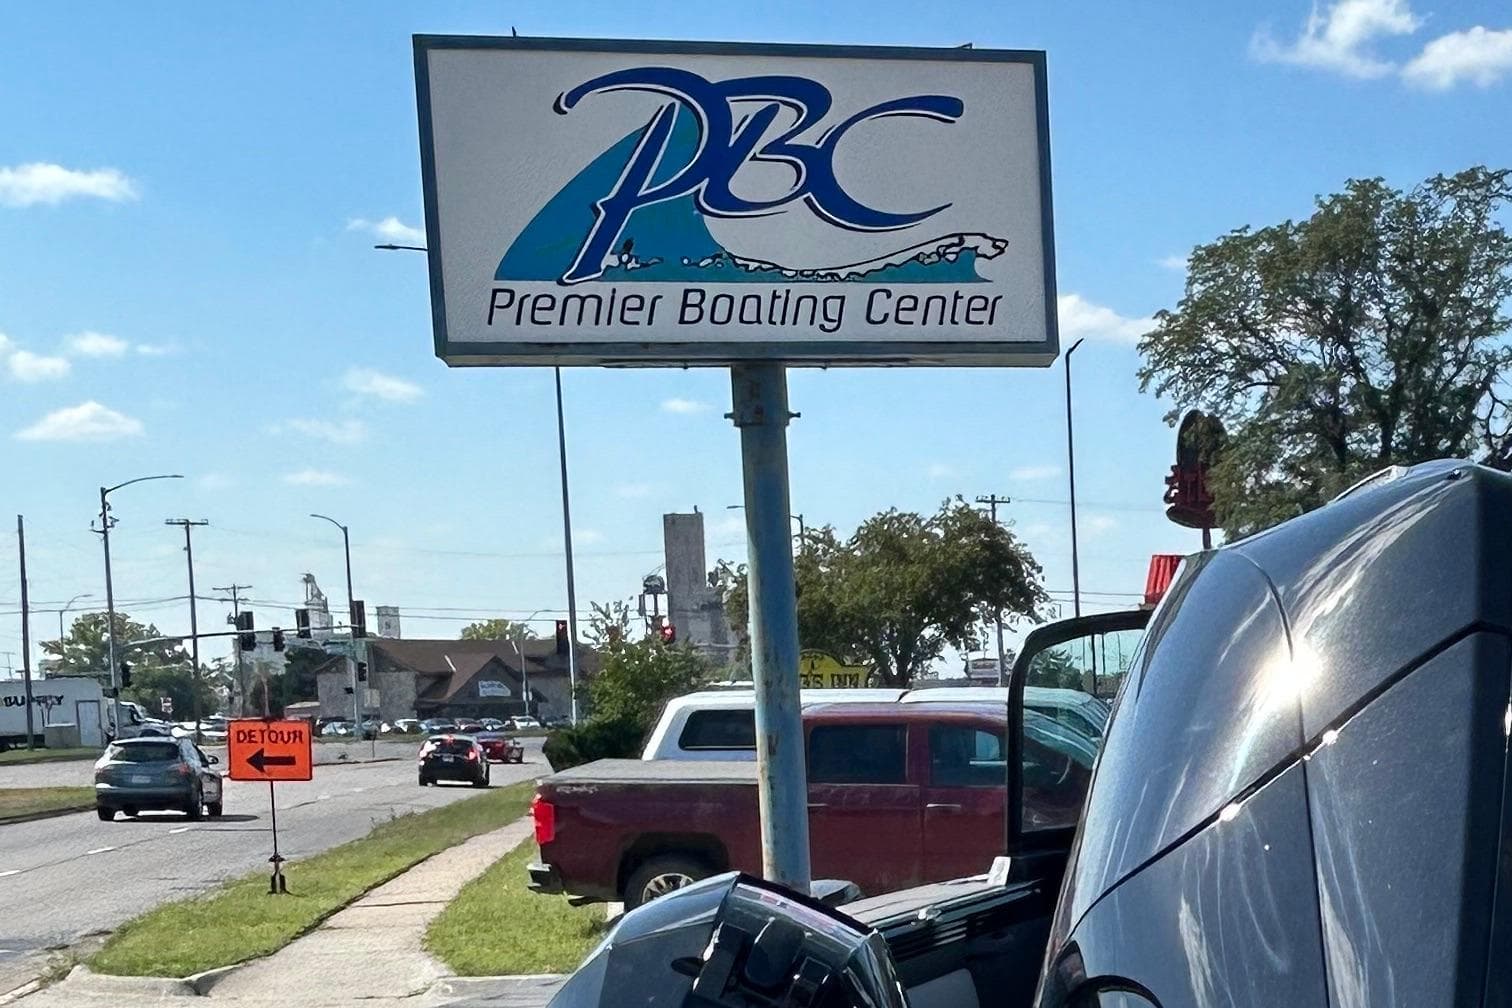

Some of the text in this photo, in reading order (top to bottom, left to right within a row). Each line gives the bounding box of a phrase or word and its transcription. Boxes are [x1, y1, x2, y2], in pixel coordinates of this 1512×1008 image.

[553, 66, 964, 286] PBC
[487, 287, 1003, 333] Premier Boating Center
[236, 728, 304, 744] DETOUR
